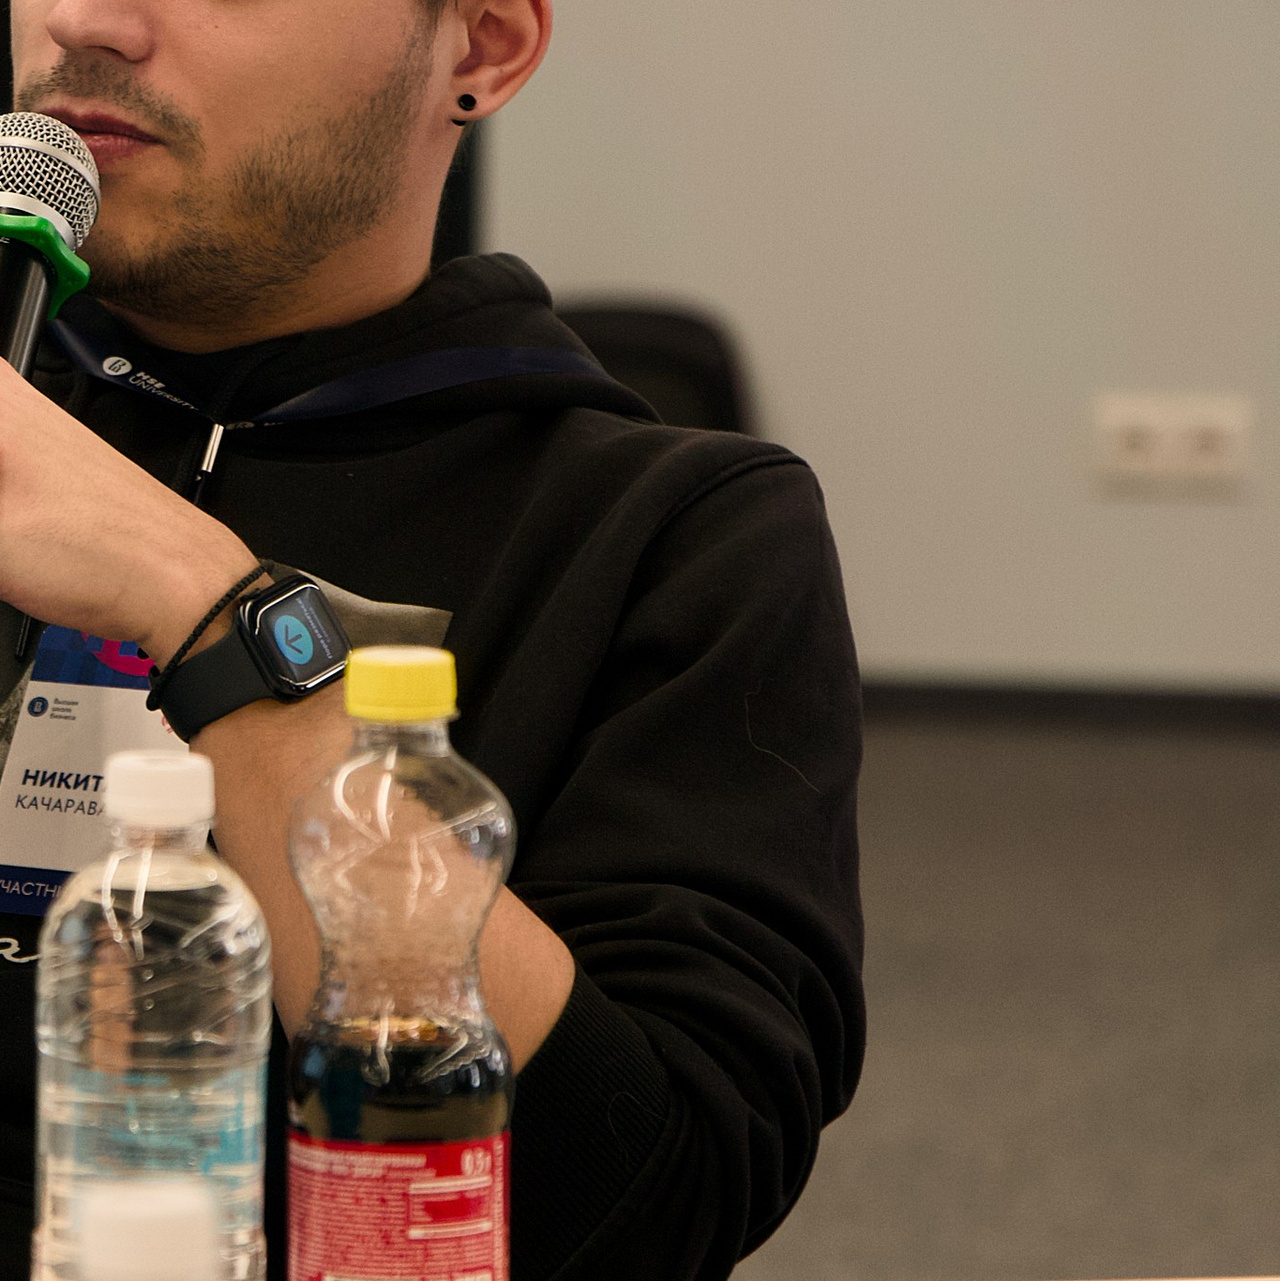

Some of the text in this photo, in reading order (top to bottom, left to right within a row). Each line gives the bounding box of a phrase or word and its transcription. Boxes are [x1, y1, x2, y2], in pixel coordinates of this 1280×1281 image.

[136, 372, 166, 389] HSE
[129, 376, 199, 411] UNIVERSITY
[22, 768, 106, 792] НИКИТ
